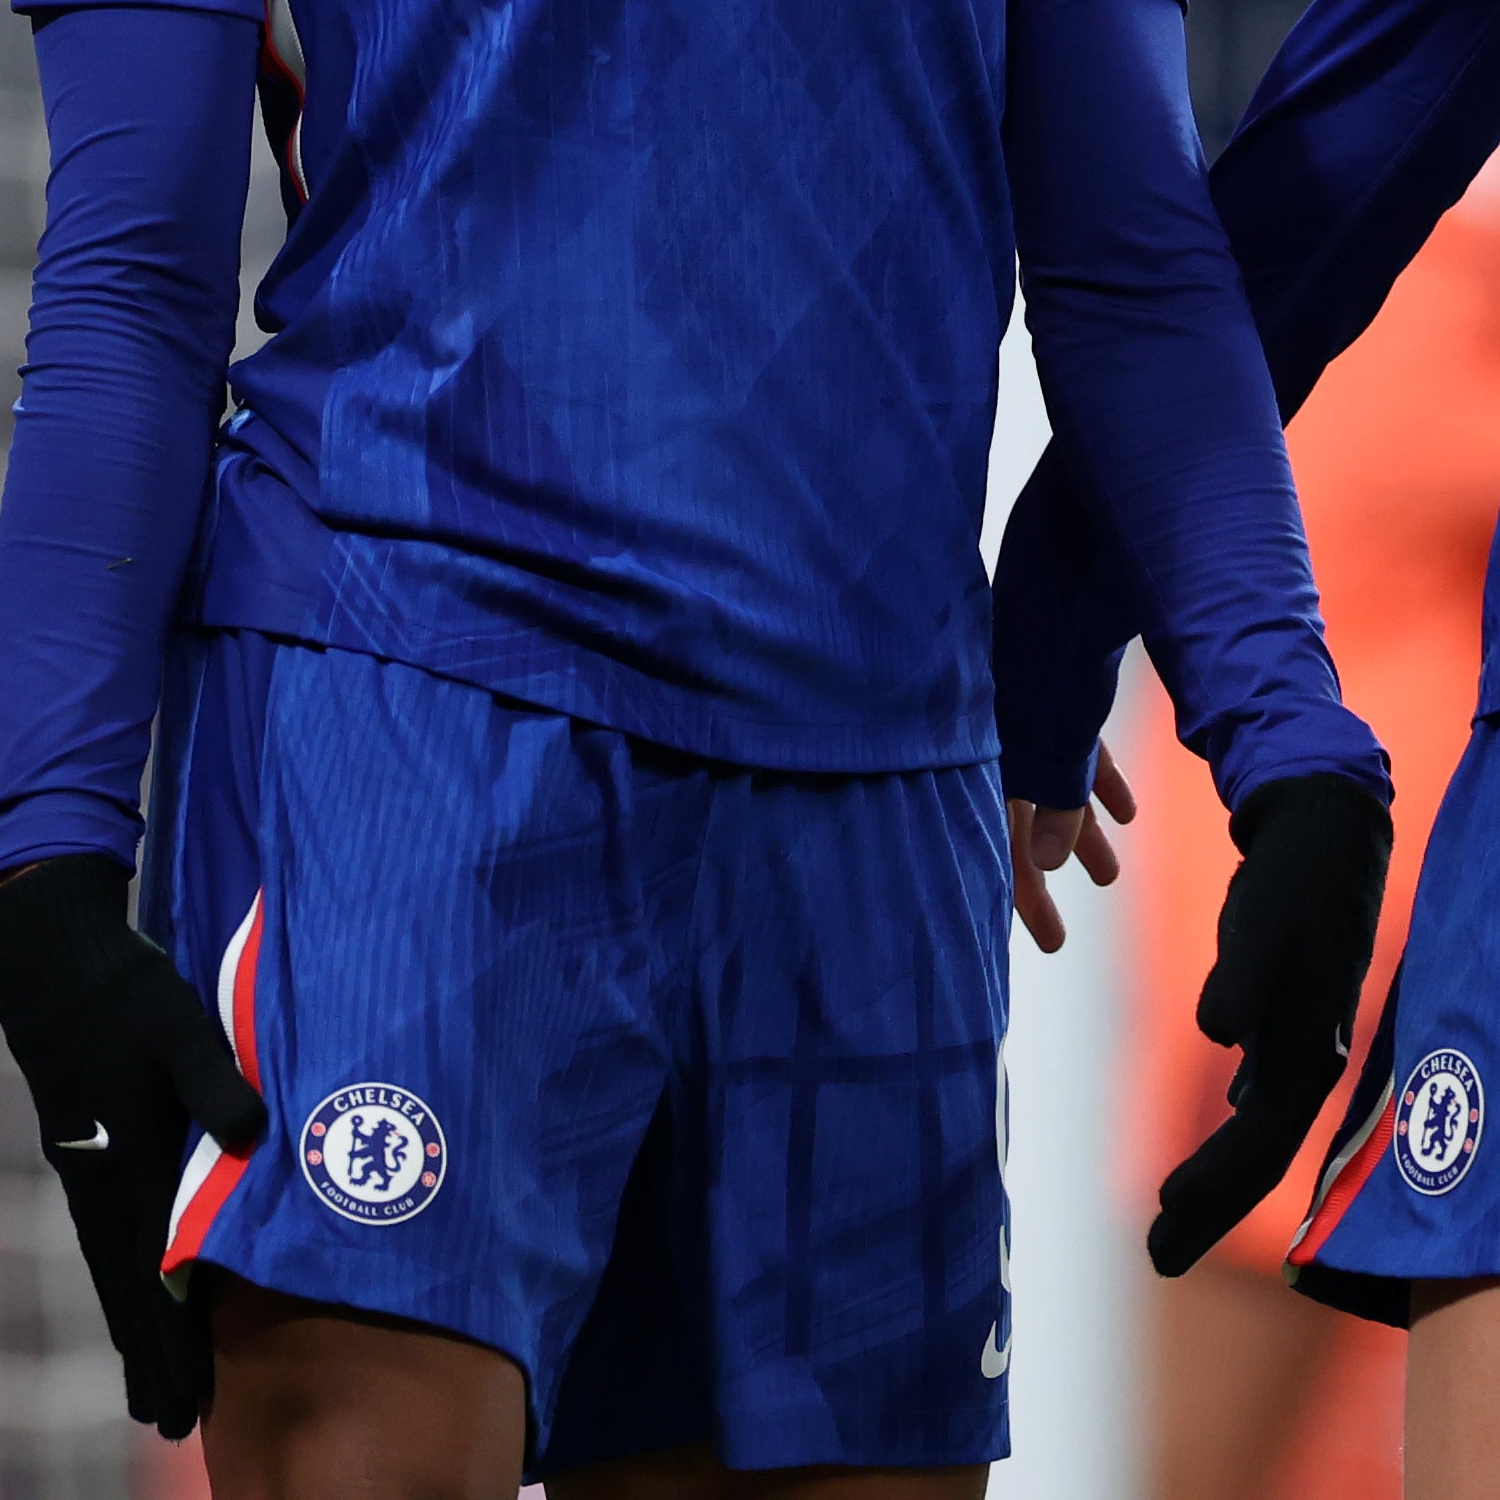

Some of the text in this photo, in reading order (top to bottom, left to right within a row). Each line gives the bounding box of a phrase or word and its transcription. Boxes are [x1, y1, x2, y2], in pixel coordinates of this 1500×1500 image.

[1421, 1055, 1475, 1092] CHELSEA
[333, 1088, 426, 1126] CHELSEA
[1402, 1153, 1435, 1187] FOOTBALL
[320, 1181, 415, 1216] FOOTBALL CLUB
